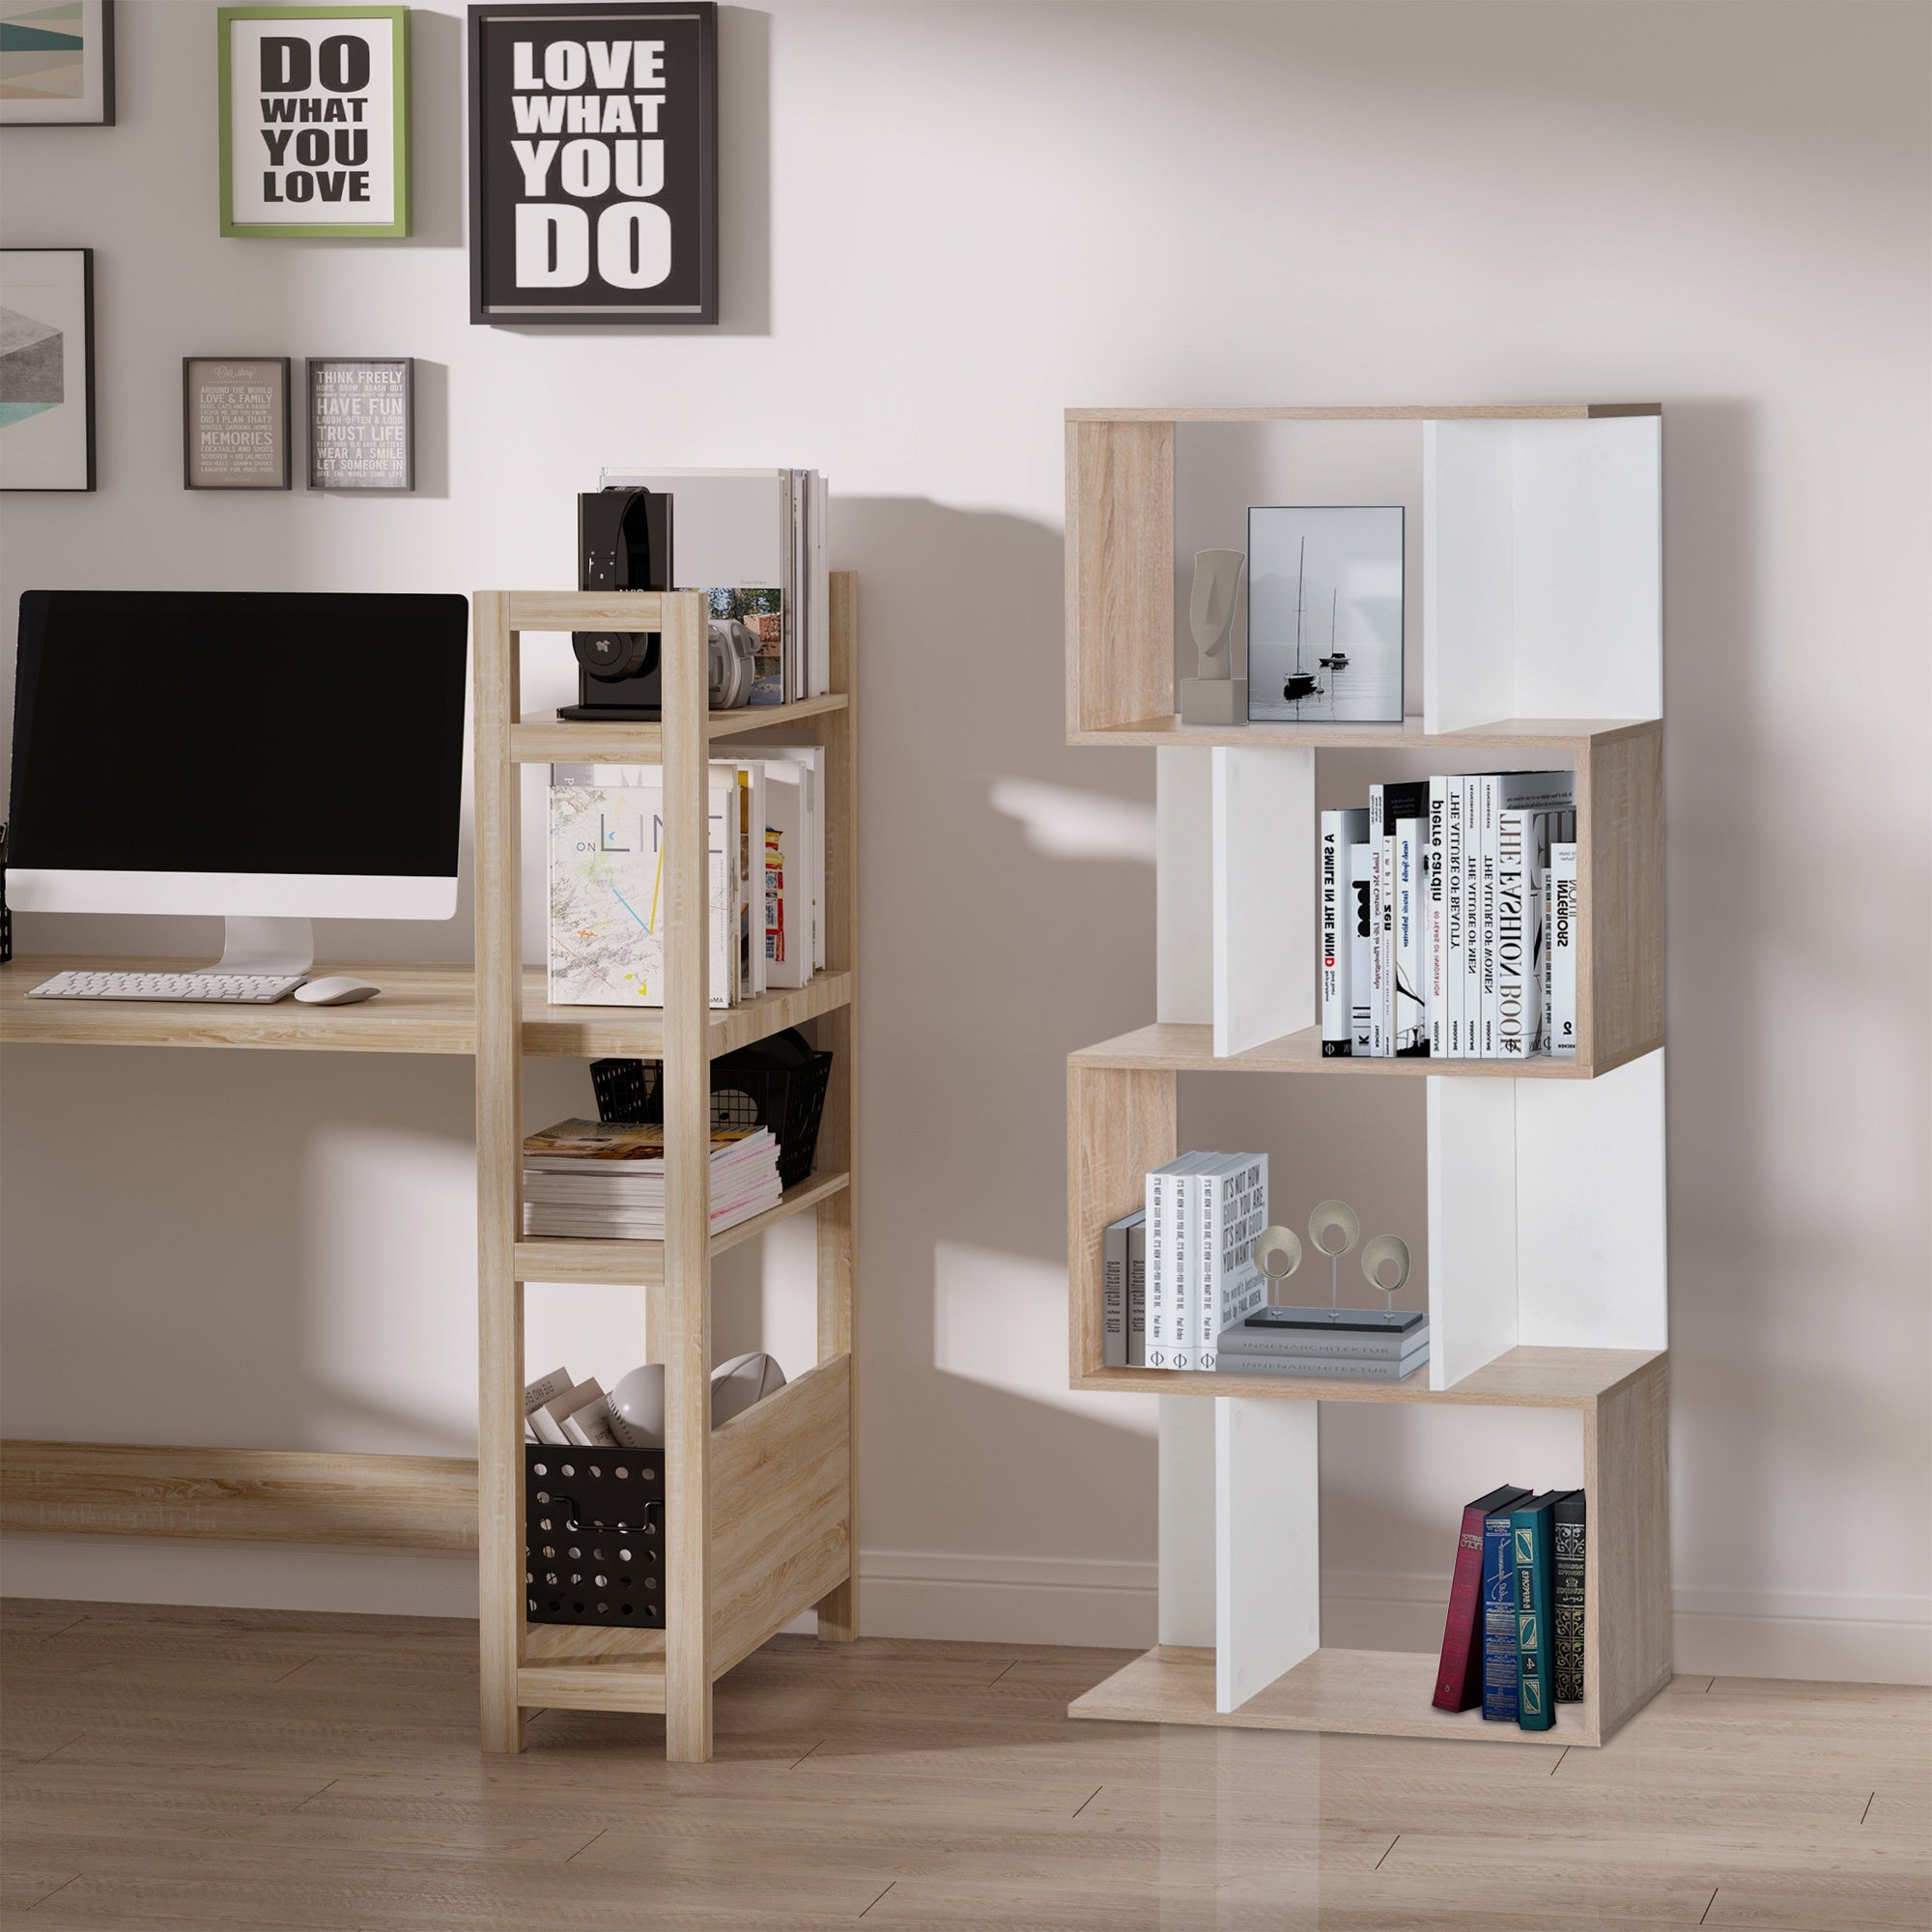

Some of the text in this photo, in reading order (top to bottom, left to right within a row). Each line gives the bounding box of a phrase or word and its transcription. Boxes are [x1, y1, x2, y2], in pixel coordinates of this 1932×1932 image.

[260, 35, 370, 93] DO
[513, 41, 666, 90] LOVE
[260, 98, 369, 123] WHAT
[512, 95, 666, 133] WHAT
[260, 128, 369, 166] YOU
[510, 139, 665, 198] YOU
[263, 171, 370, 202] LOVE
[515, 201, 671, 289] DO
[317, 371, 402, 384] THINK FREELY
[200, 394, 272, 403] LOVE & FAMILY
[317, 398, 402, 415] HAVE FUN
[200, 415, 214, 424] DID
[222, 415, 244, 424] PLAN
[246, 415, 272, 424] THAT?
[317, 416, 402, 424] LAUGH OFTEN & LOUD
[201, 432, 272, 445] MEMORIES
[317, 426, 403, 441] TRUST LIFE
[317, 448, 402, 459] WEAR A SMILE
[317, 459, 402, 470] LET SOMEONE IN
[576, 842, 596, 852] ON
[1223, 1164, 1260, 1202] IT'S NOT HOW
[1224, 1200, 1237, 1226] GOOD
[1240, 1193, 1250, 1217] YOU
[1223, 1225, 1234, 1250] IT'S
[1236, 1218, 1246, 1243] HOW
[1223, 1241, 1249, 1272] YOU WANT
[1244, 1342, 1389, 1354] INNENARCHITEKTUR
[1242, 1362, 1387, 1374] INNENARCHITEKTUR
